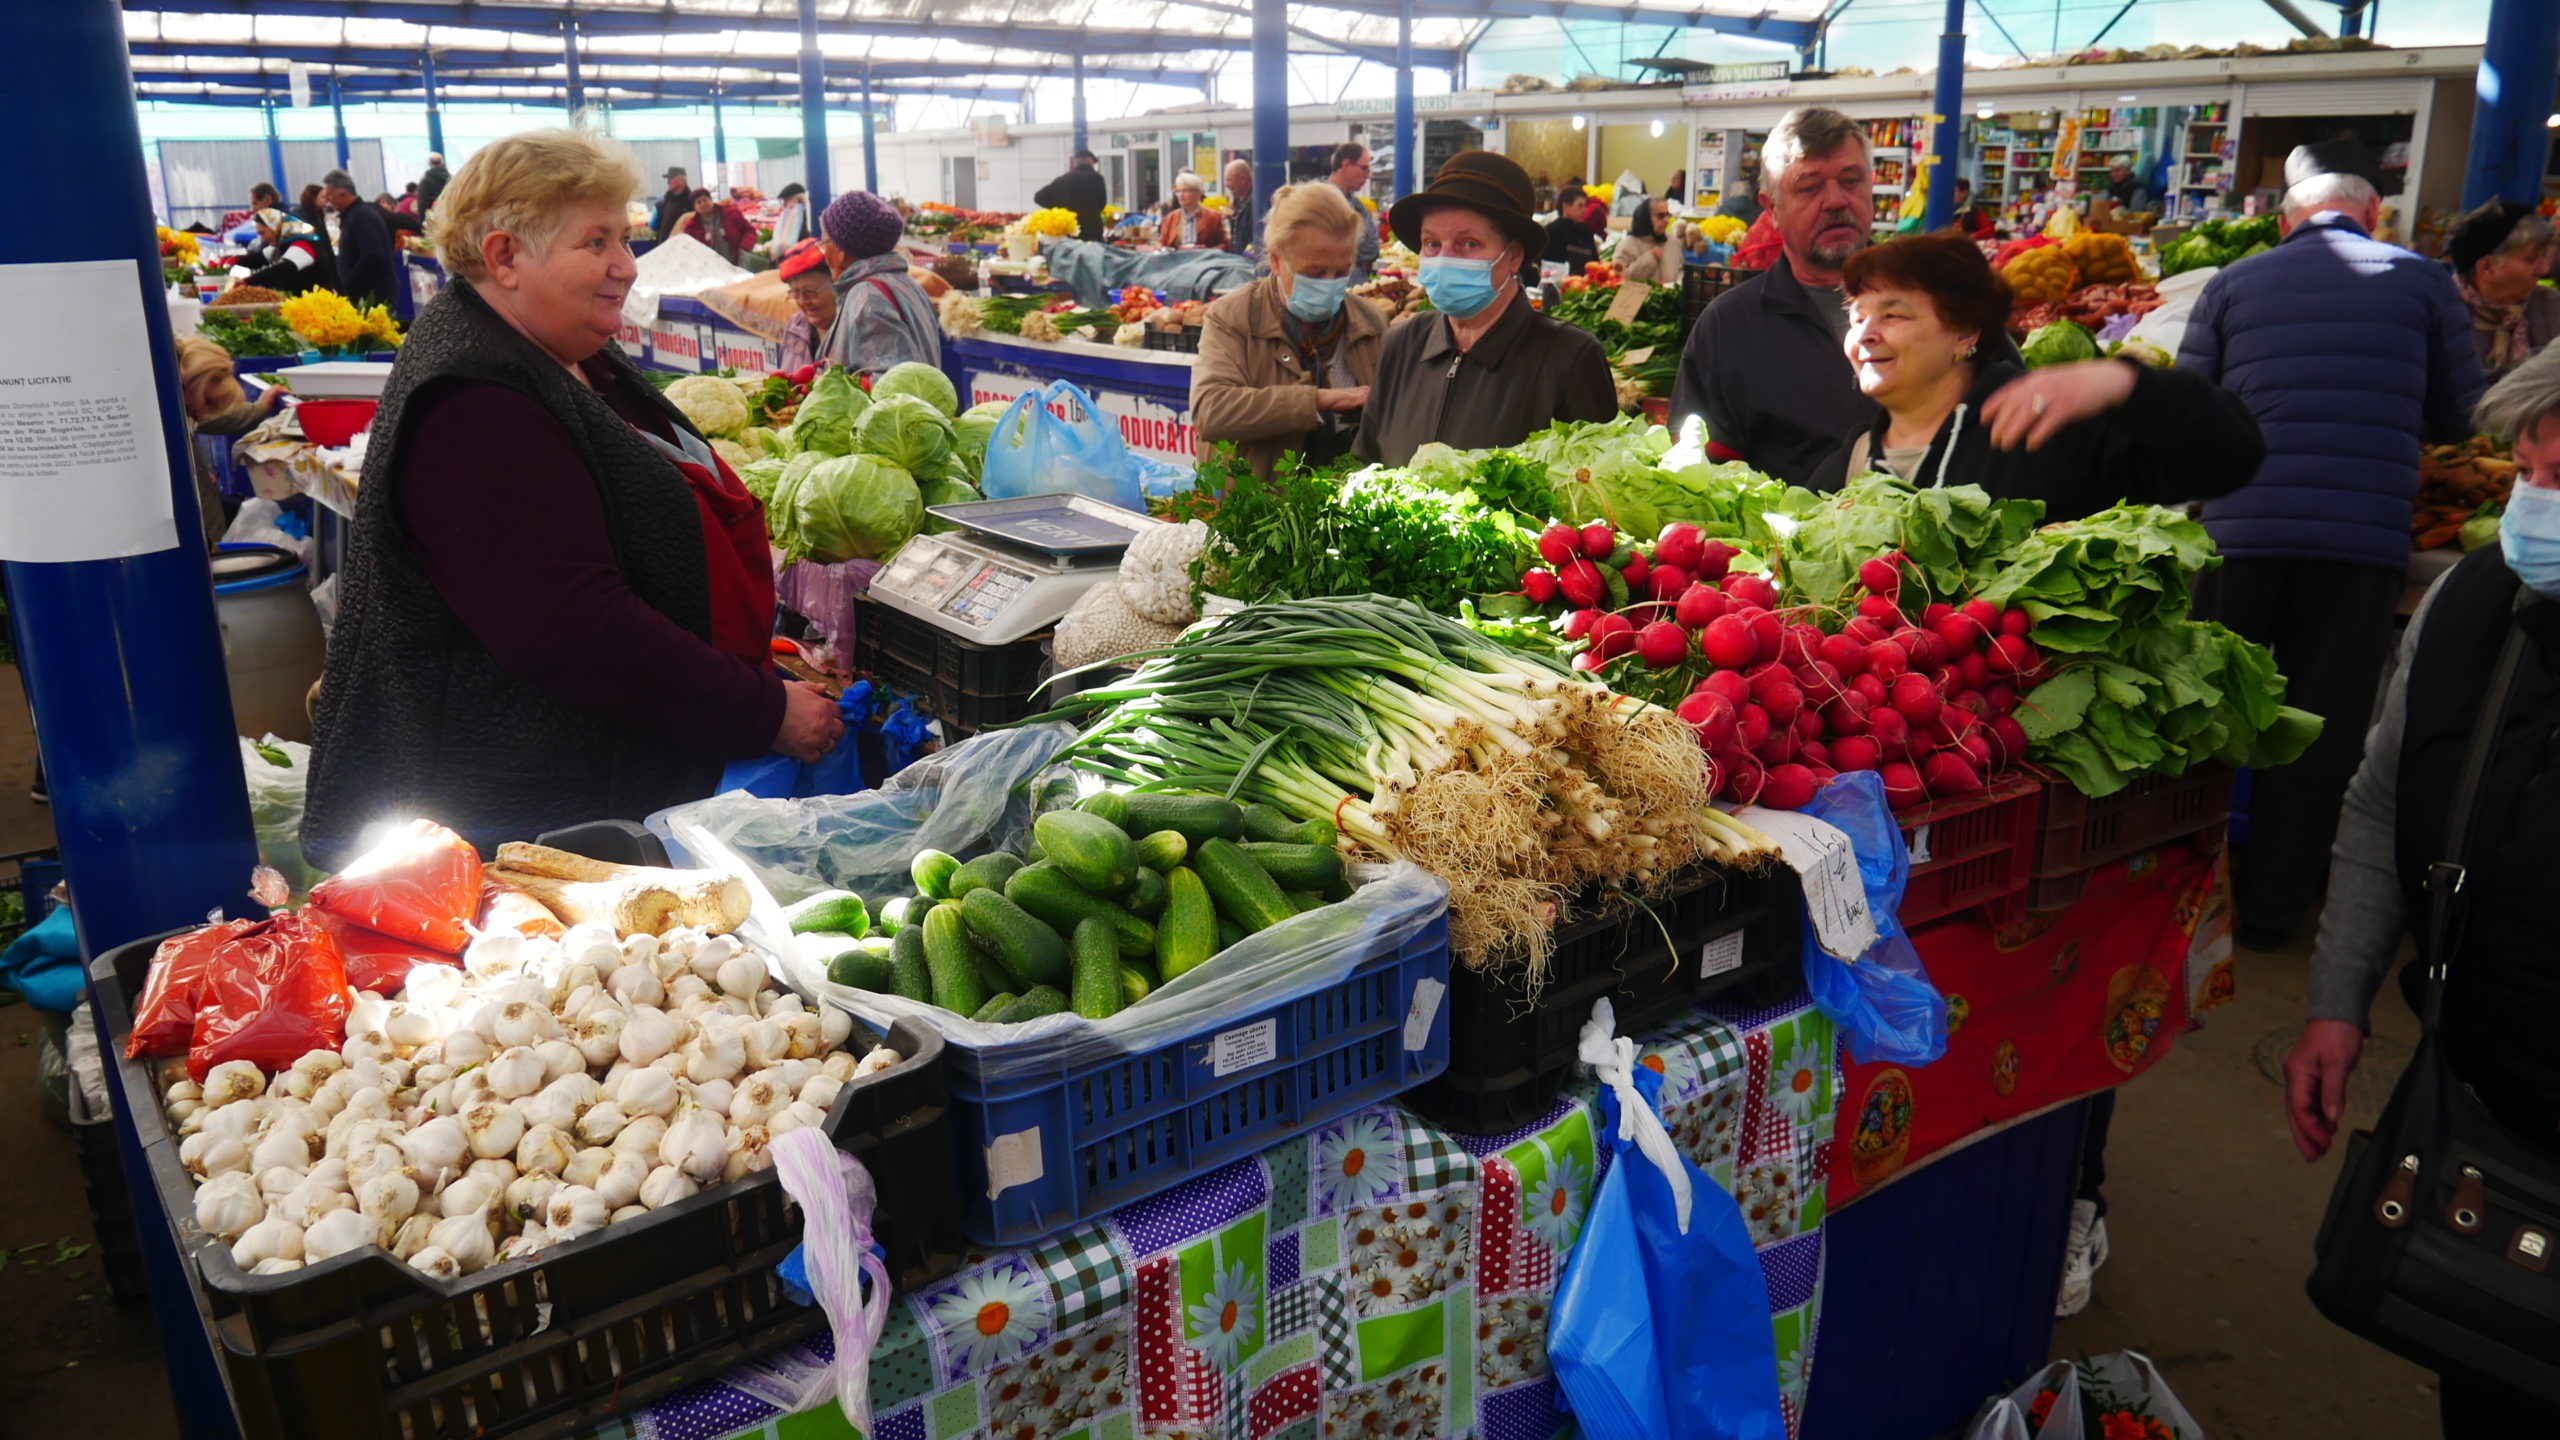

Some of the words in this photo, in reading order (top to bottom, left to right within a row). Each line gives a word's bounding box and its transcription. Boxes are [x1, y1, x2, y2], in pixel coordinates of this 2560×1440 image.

[1686, 67, 1733, 83] MAGAZIN
[1736, 63, 1788, 81] NATURIST
[1338, 98, 1393, 113] MAGAZIN
[97, 405, 112, 414] ADP
